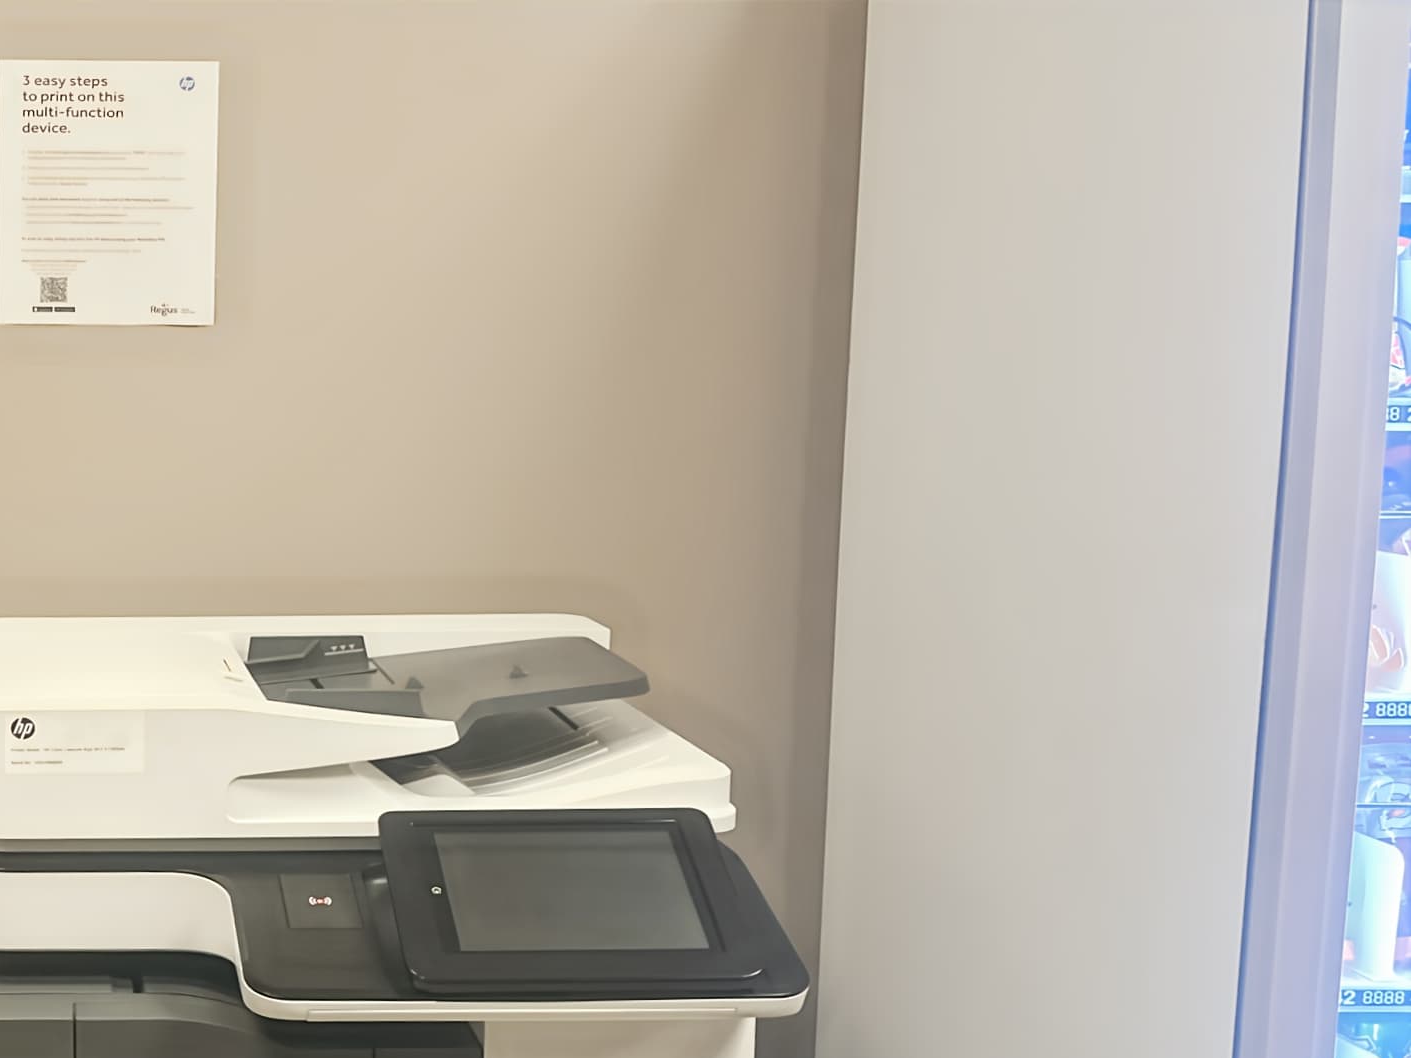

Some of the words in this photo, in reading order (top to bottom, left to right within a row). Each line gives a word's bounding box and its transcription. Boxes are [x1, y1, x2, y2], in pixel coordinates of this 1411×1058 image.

[22, 75, 30, 86] 3
[34, 77, 66, 89] easy
[70, 76, 108, 89] steps
[22, 91, 37, 102] to
[41, 91, 74, 104] print
[77, 93, 95, 102] on
[99, 91, 125, 102] this
[22, 106, 124, 118] multi-function
[22, 122, 71, 133] device.
[11, 717, 35, 740] hp
